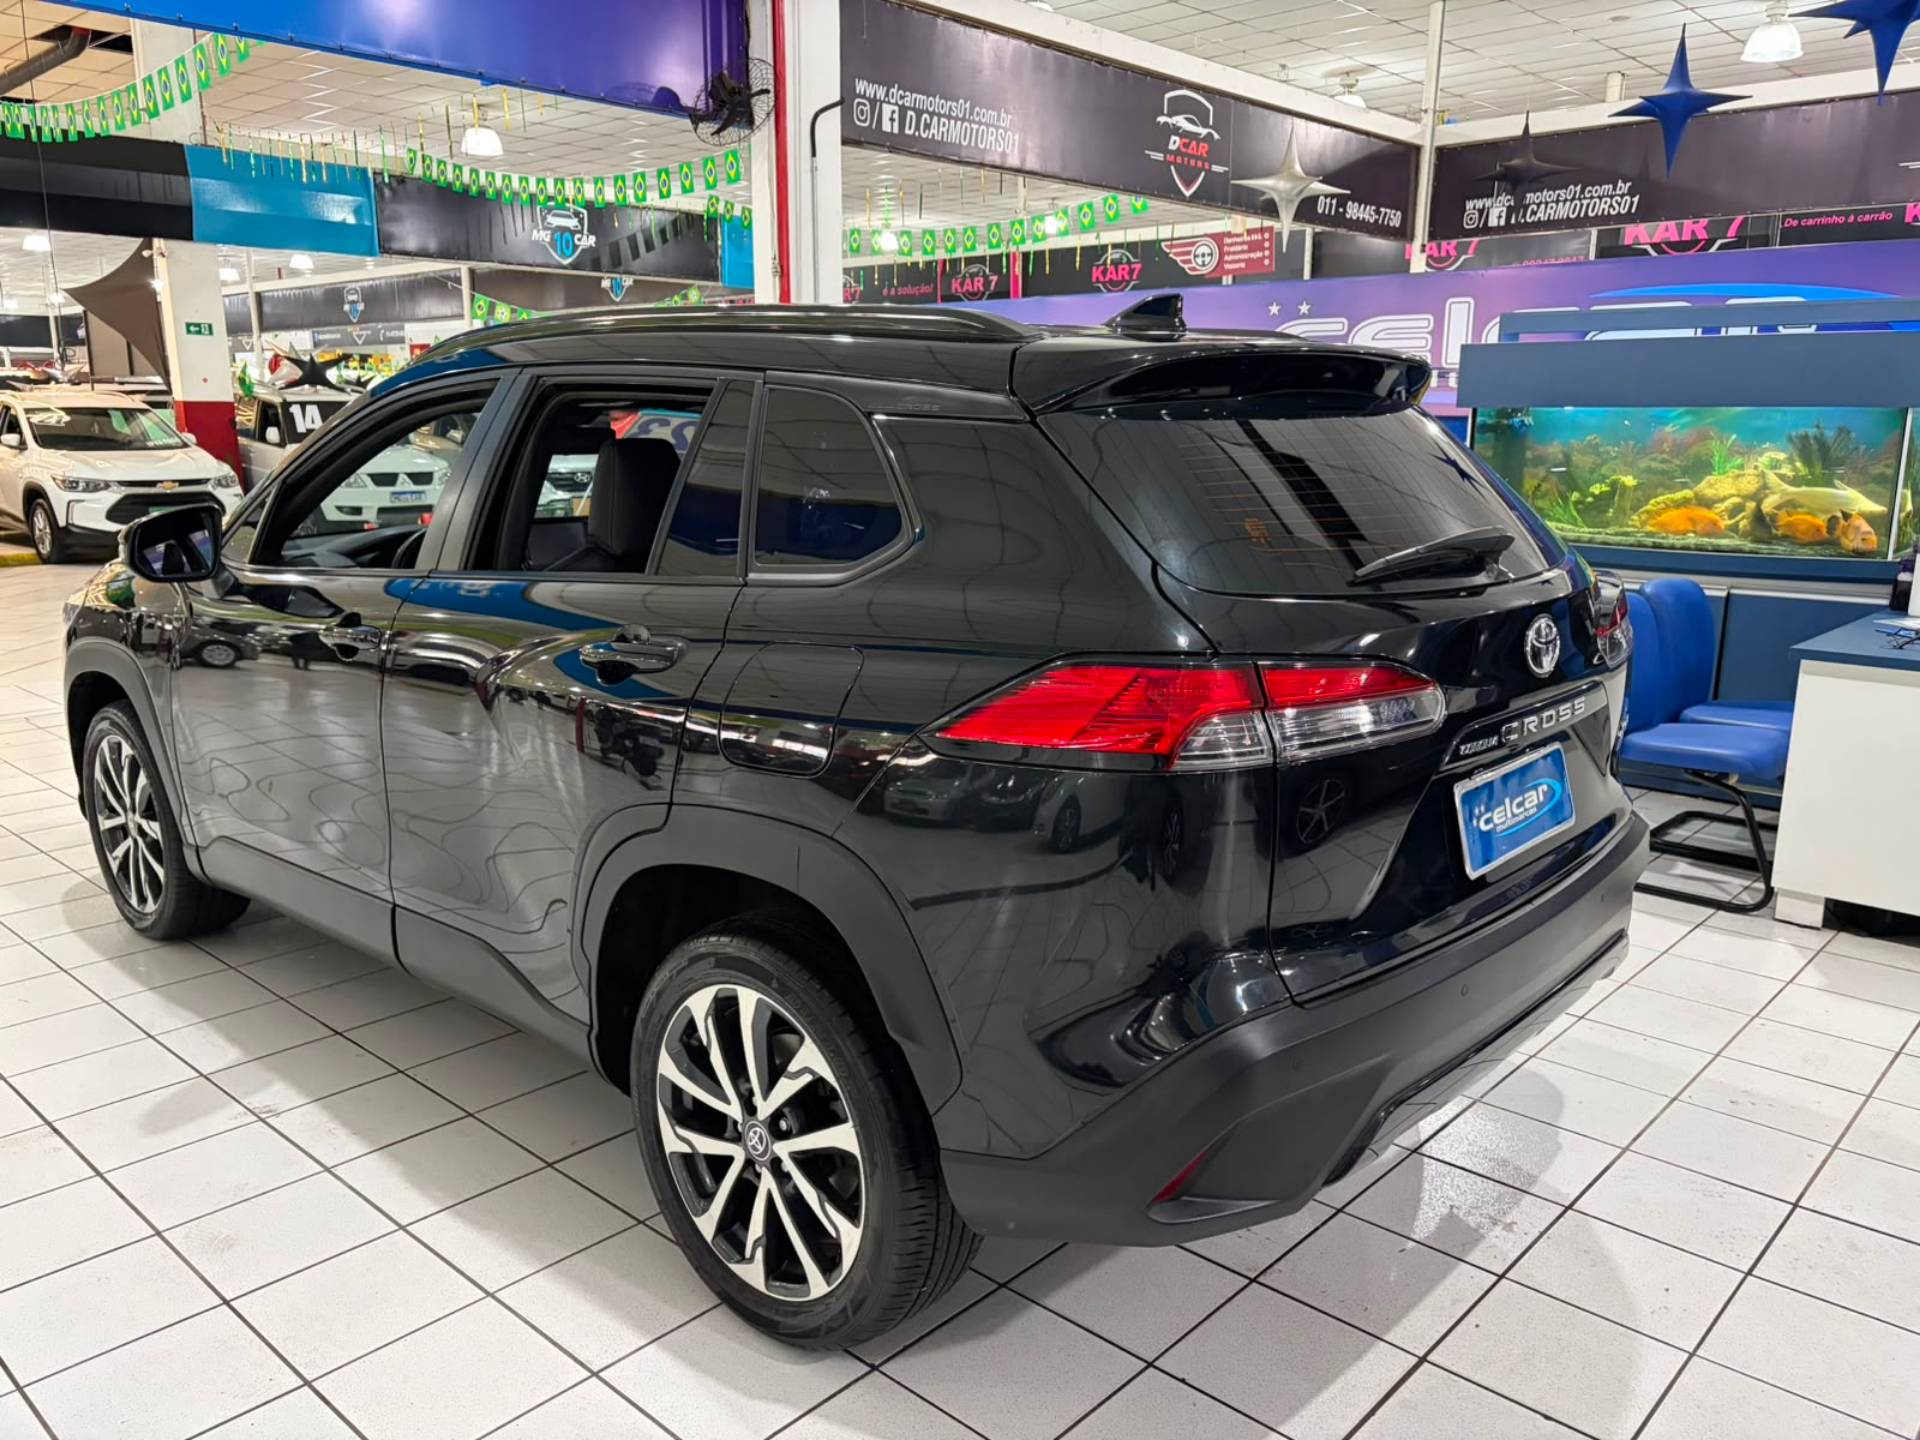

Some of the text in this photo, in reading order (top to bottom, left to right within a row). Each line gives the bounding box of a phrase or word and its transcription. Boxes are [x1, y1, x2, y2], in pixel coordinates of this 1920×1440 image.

[855, 78, 1013, 128] www.dcarmotors01.com.br
[905, 110, 1020, 153] D.CARMOTORS01
[1168, 135, 1209, 157] DCAR
[1317, 195, 1337, 216] 011
[1345, 200, 1402, 228] 98445-7750
[1784, 217, 1799, 228] De
[1800, 214, 1845, 226] carrinho
[1857, 211, 1893, 223] carrão
[554, 231, 573, 257] 10
[574, 233, 597, 248] CAR
[1624, 219, 1709, 246] KAR
[952, 275, 998, 293] KAR 7
[1092, 263, 1142, 282] KAR 7
[1501, 696, 1585, 743] CROSS
[1479, 784, 1548, 832] celcar
